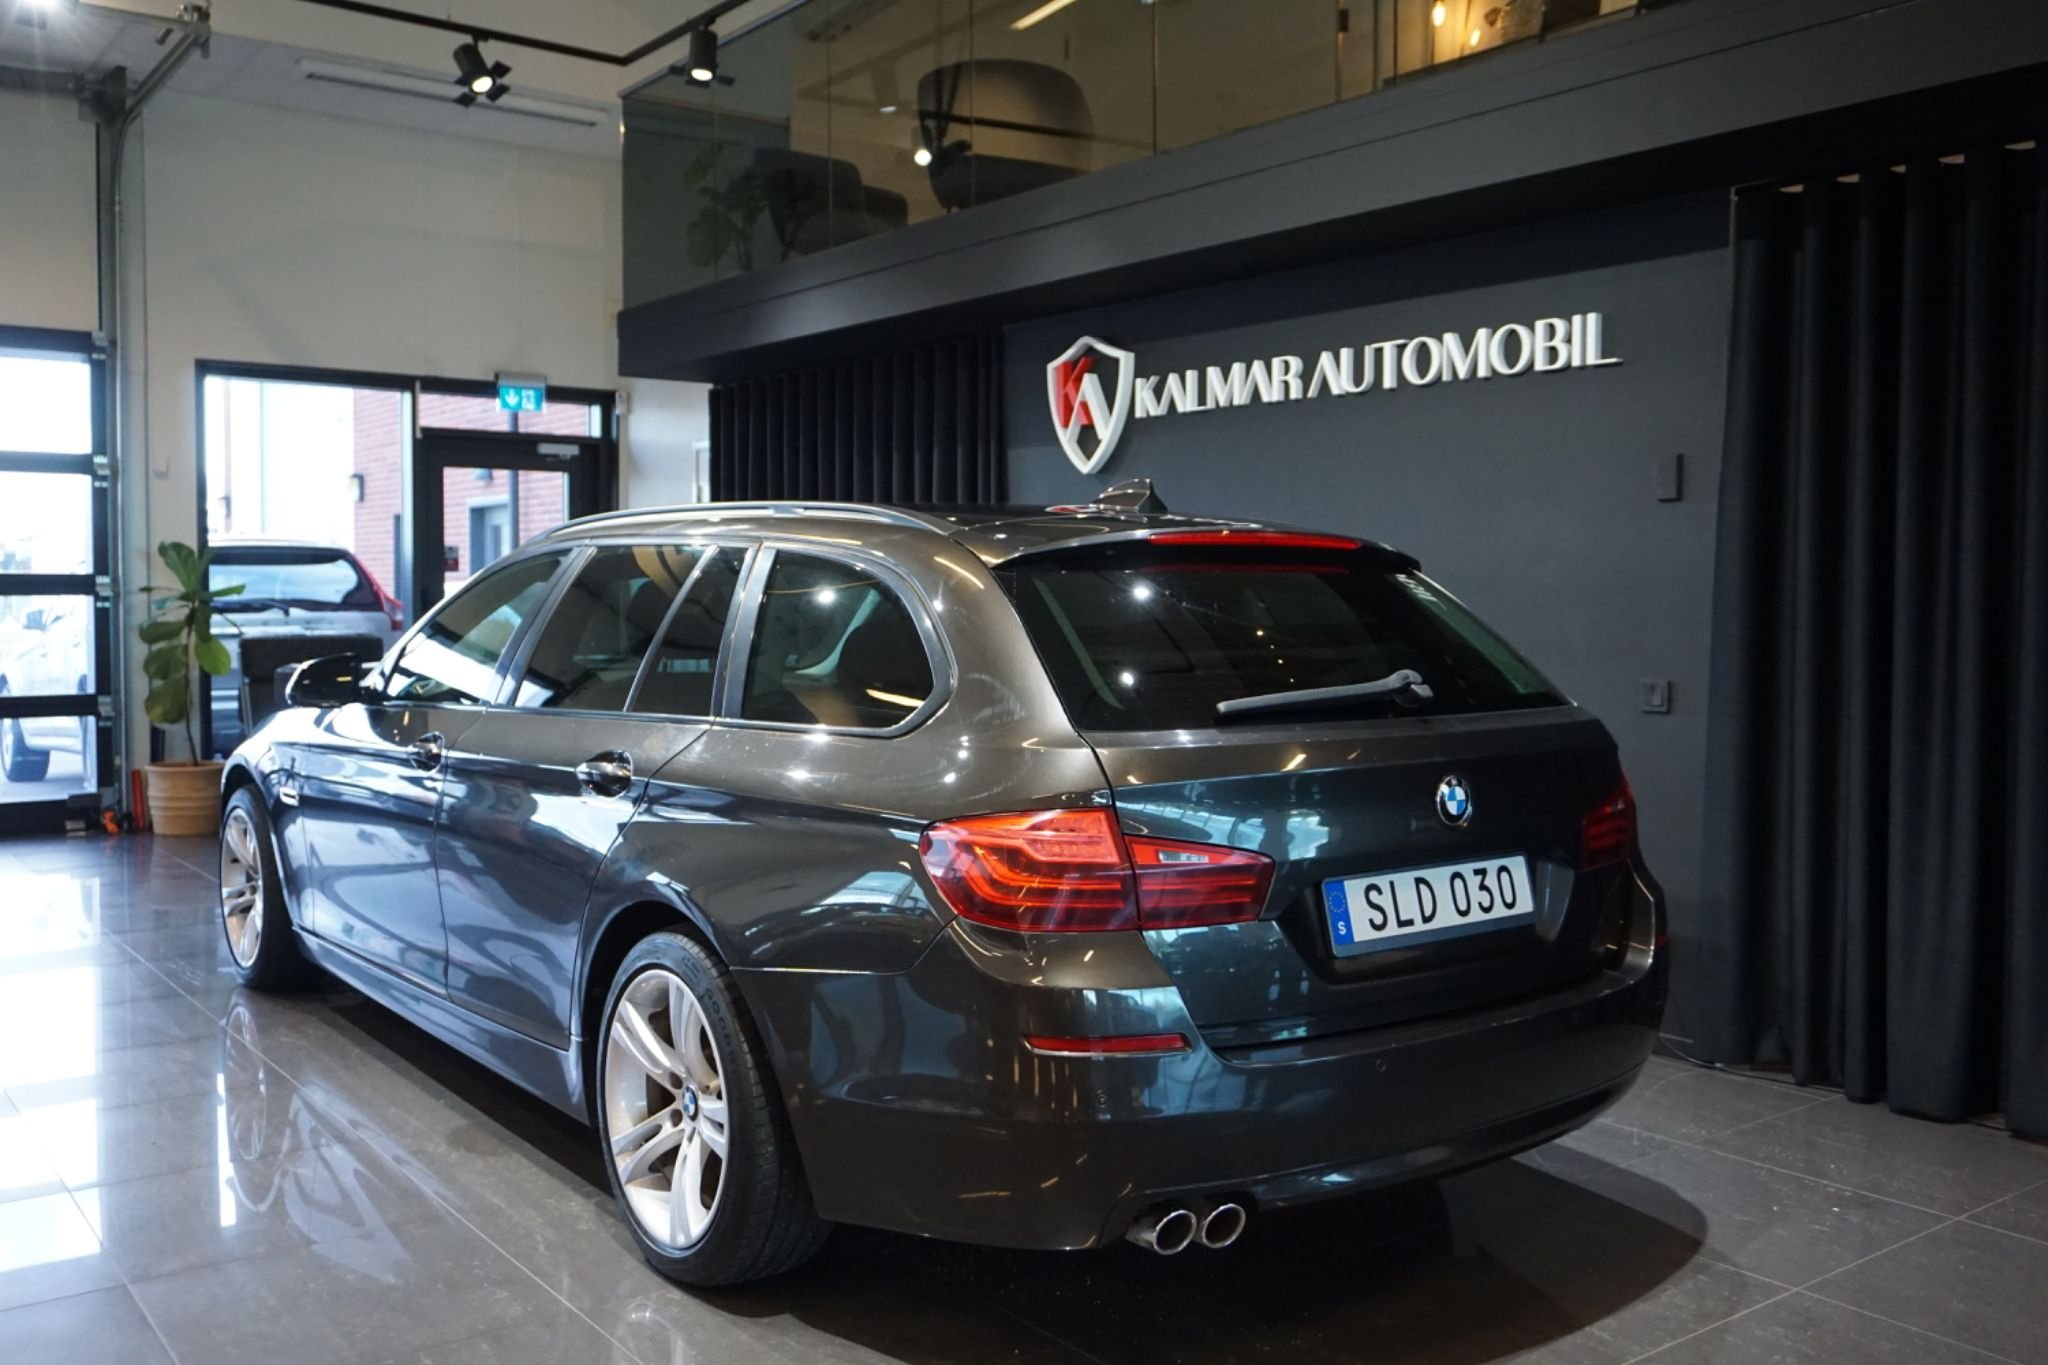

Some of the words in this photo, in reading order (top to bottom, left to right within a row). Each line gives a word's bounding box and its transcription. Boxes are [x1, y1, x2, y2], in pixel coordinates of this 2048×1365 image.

[1135, 355, 1304, 418] KALMAR
[1307, 312, 1623, 398] AUTOMOBIL
[1338, 920, 1347, 935] S
[1364, 876, 1437, 932] SLD
[1449, 864, 1517, 918] 030
